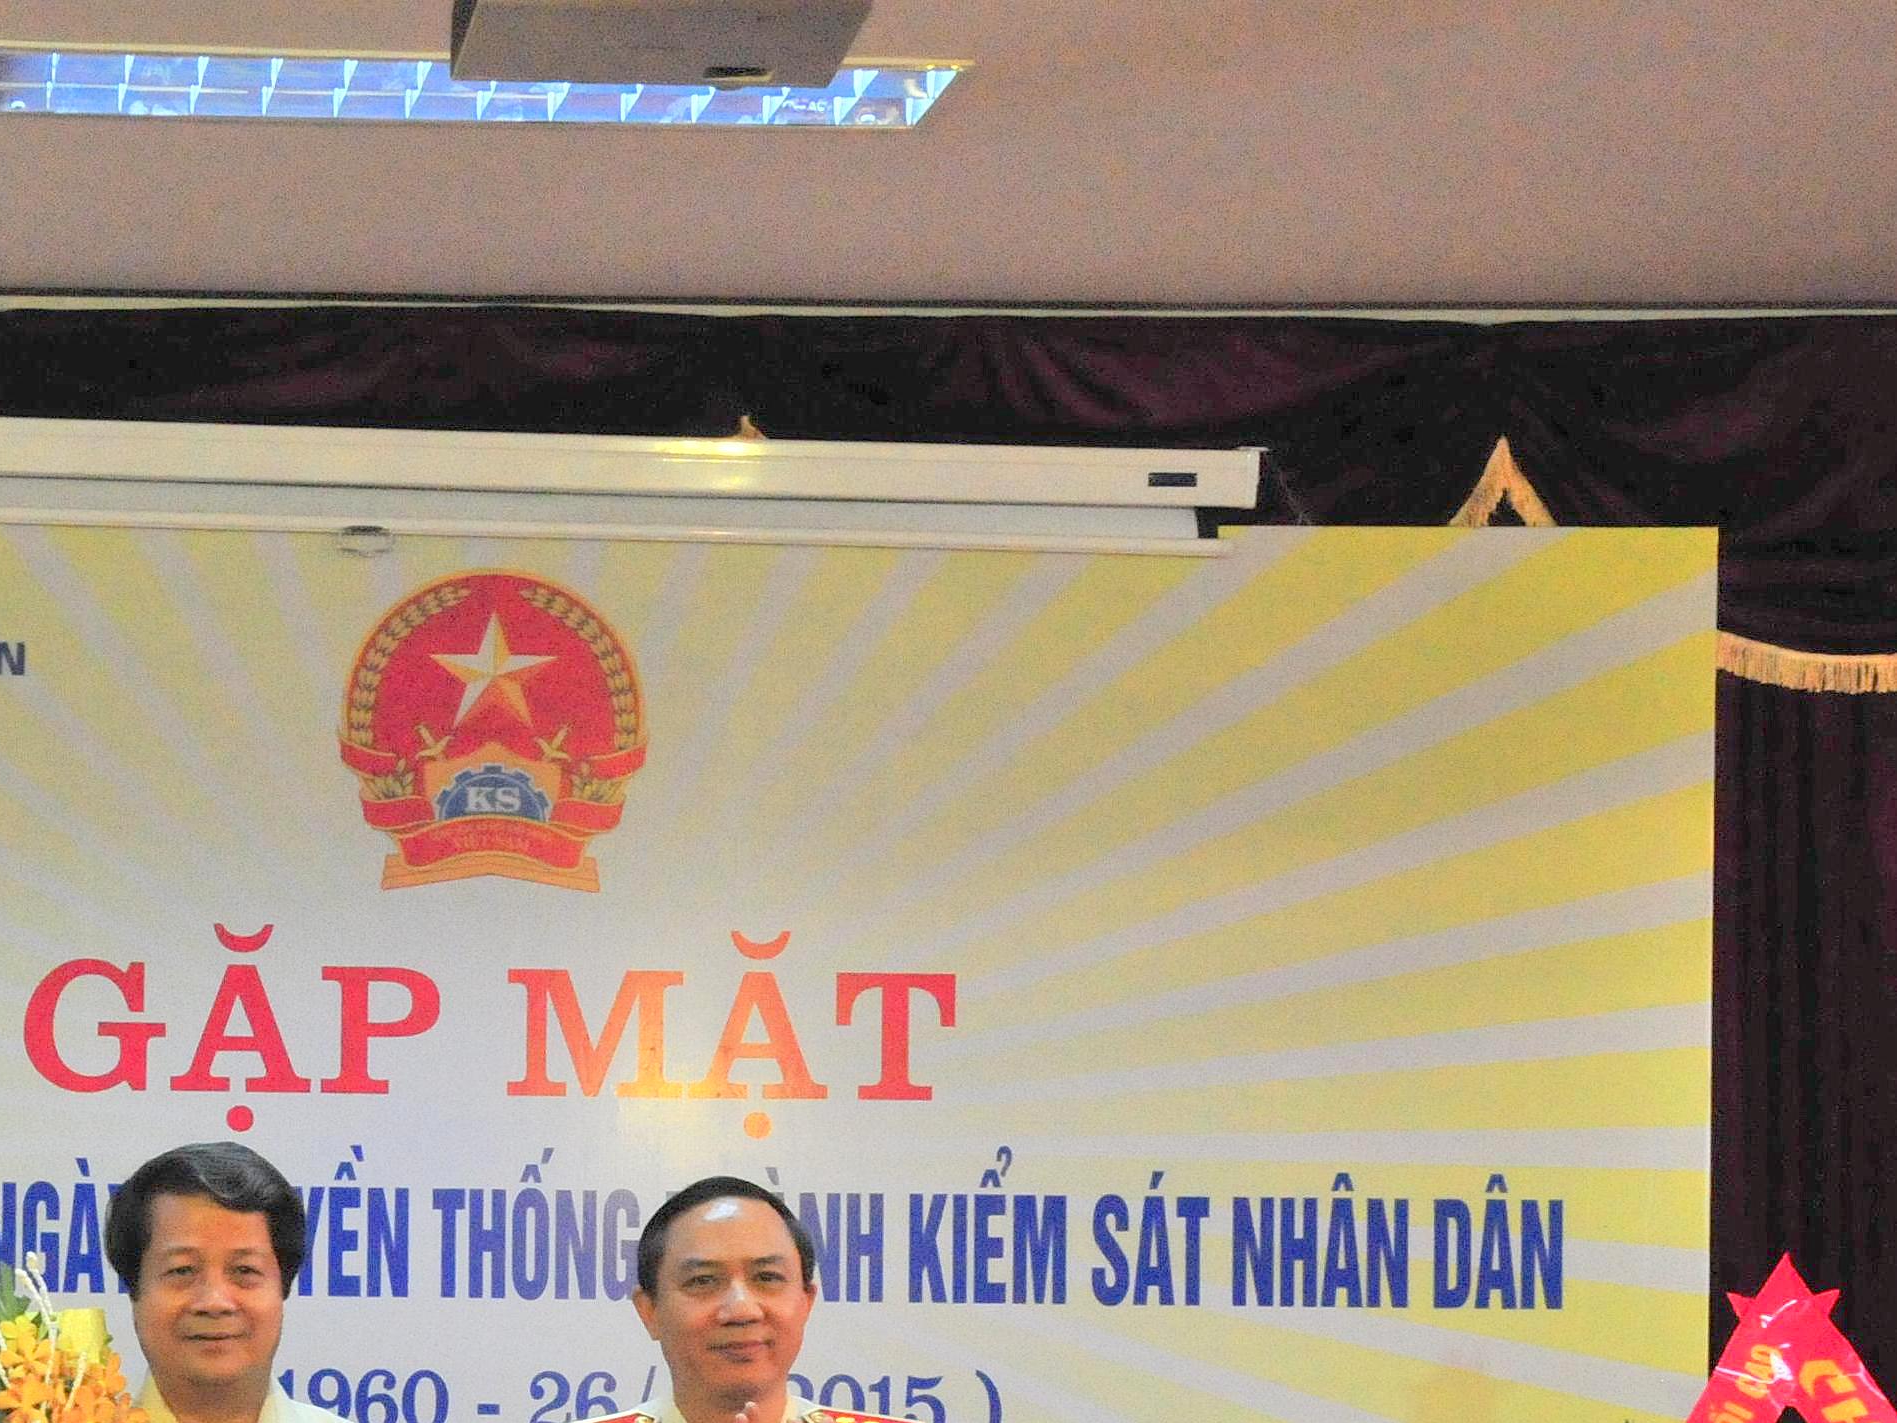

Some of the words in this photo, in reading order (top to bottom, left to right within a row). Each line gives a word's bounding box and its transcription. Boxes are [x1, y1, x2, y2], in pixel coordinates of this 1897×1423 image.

[466, 786, 522, 812] KS
[23, 922, 441, 1133] GẶP
[506, 929, 957, 1140] MẶT
[292, 1144, 410, 1298] YỀN
[432, 1146, 640, 1302] THỐNG
[908, 1145, 1068, 1304] KIỂM
[1091, 1170, 1210, 1307] SÁT
[1231, 1172, 1409, 1308] NHÂN
[1433, 1173, 1564, 1310] DÂN
